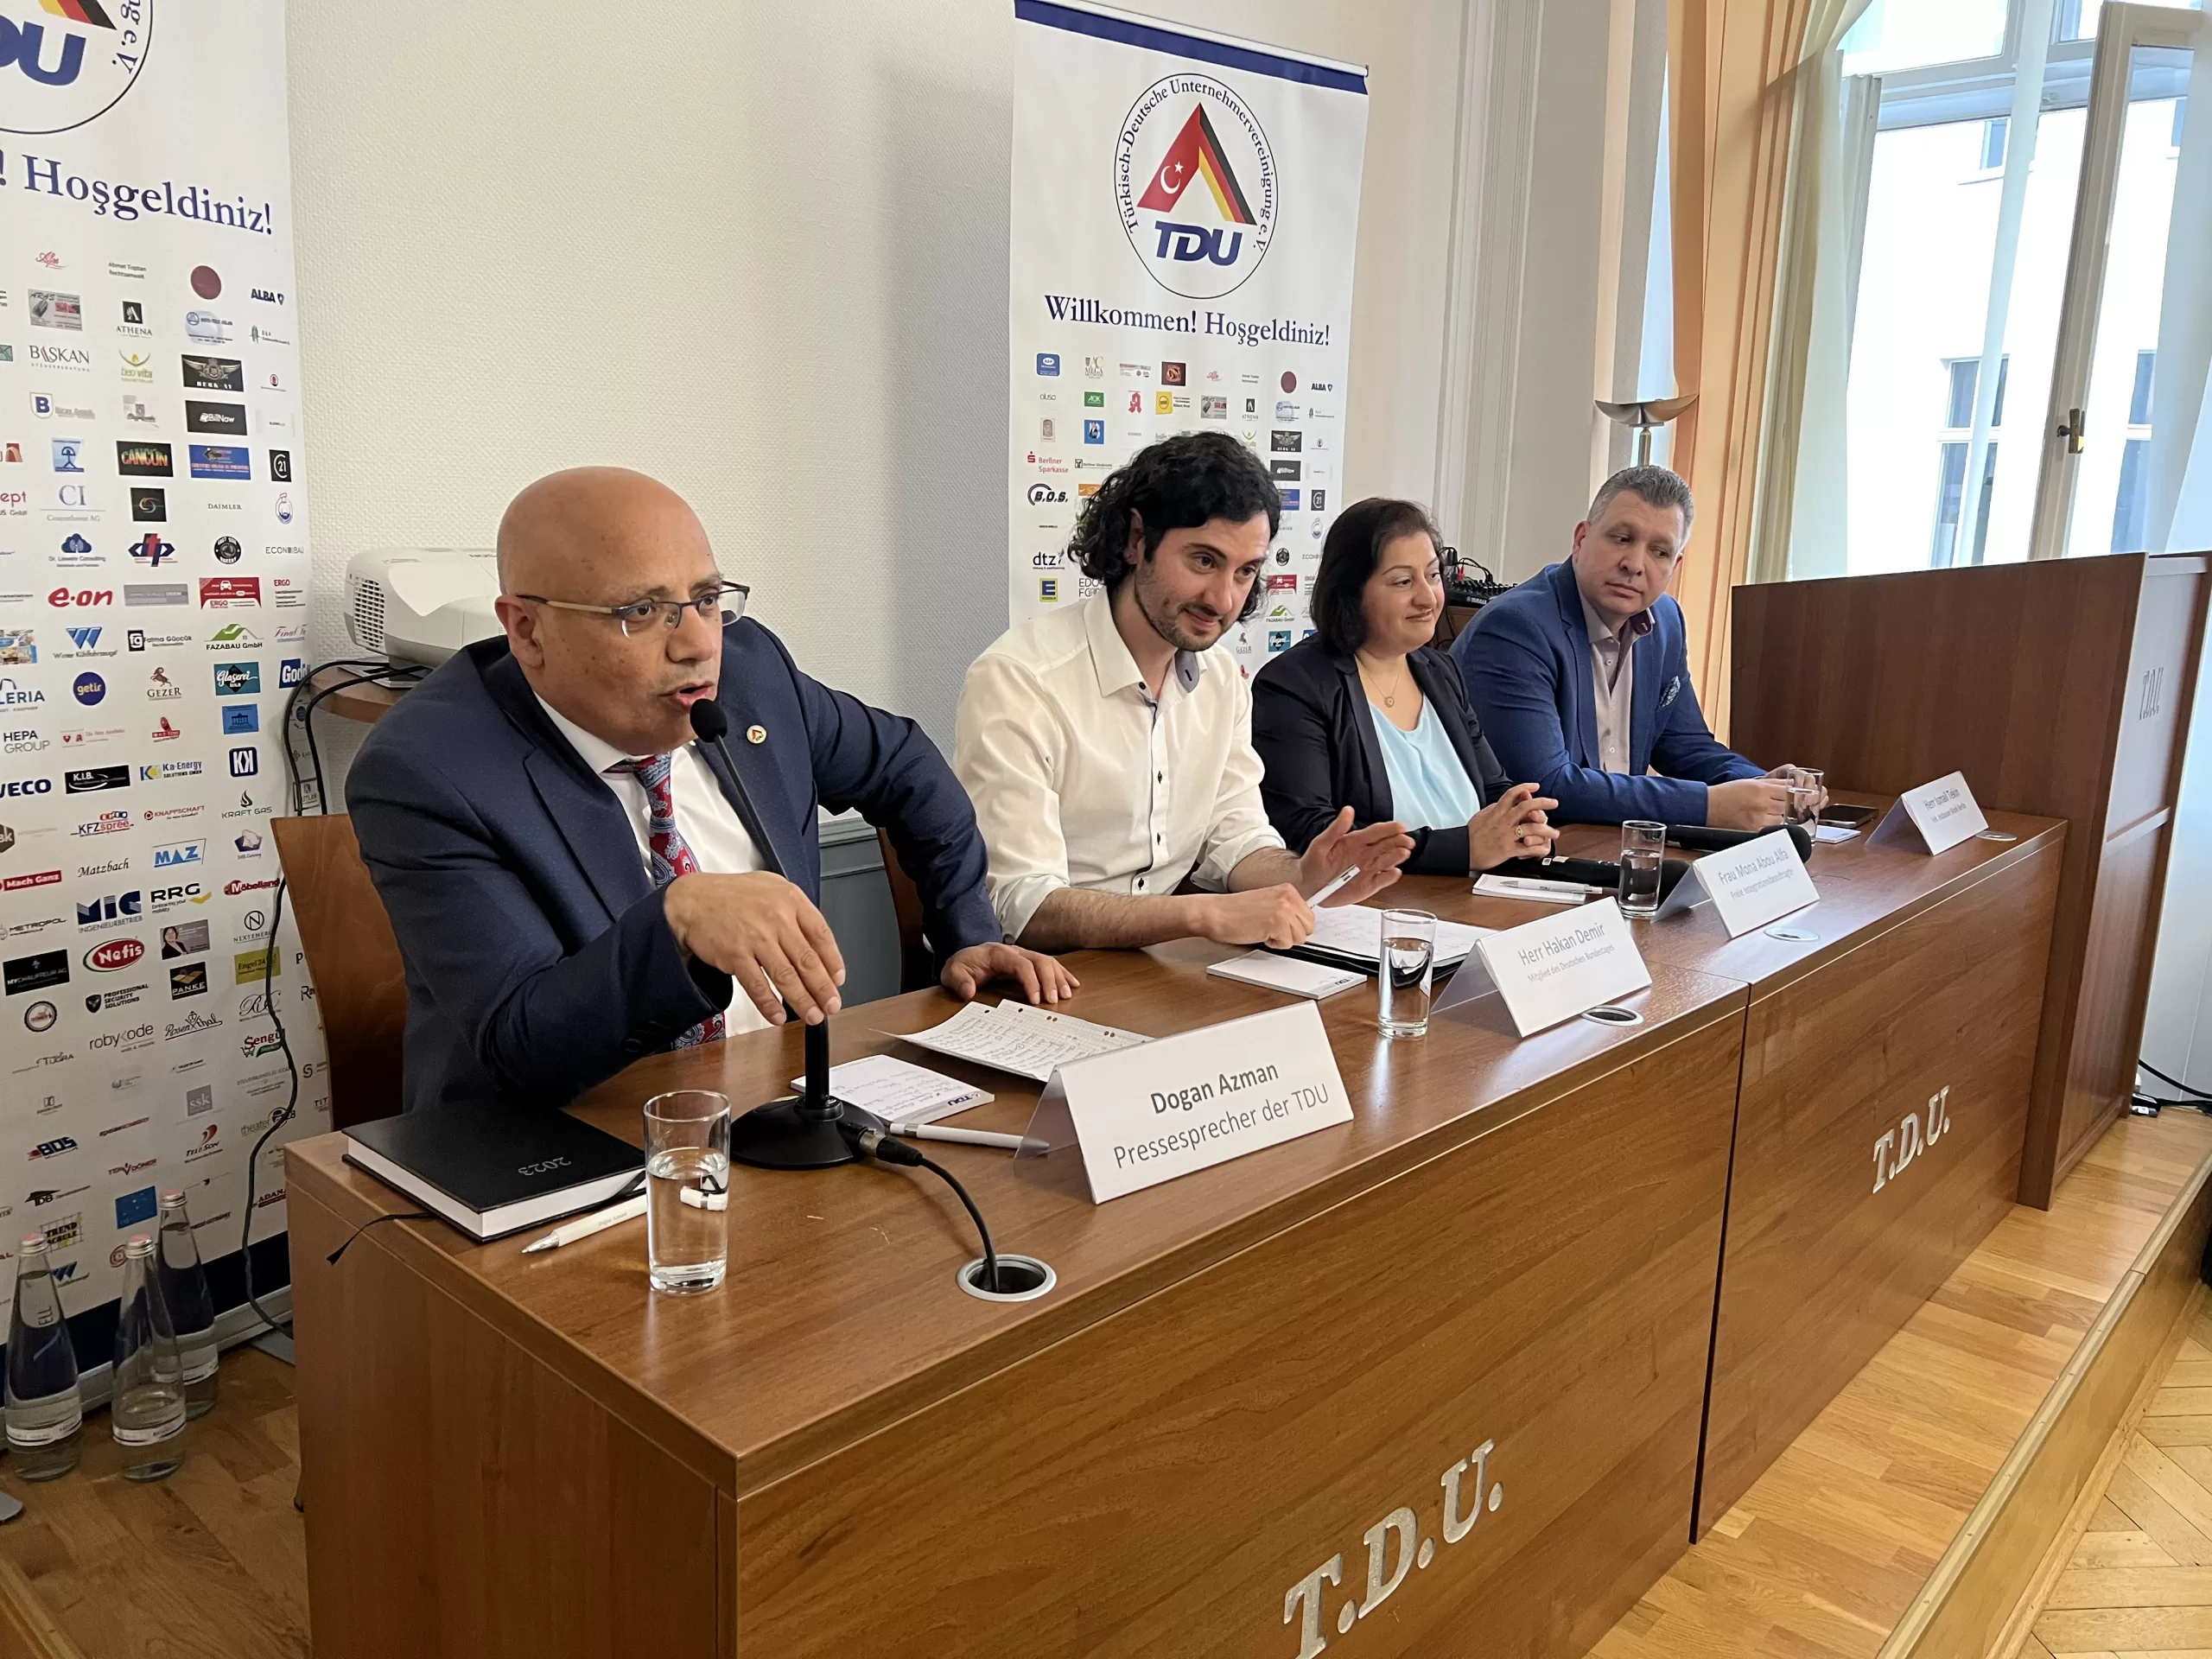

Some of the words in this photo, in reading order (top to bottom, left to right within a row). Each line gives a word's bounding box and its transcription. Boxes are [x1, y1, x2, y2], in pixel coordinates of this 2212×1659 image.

[1118, 88, 1168, 234] Türkisch-Deutsche
[1169, 79, 1274, 221] Unternehmervereinigung
[22, 154, 272, 235] Hoşgeldiniz!
[1154, 220, 1243, 266] TDU
[251, 289, 276, 303] ALBA
[1045, 295, 1196, 334] Willkommen!
[1205, 311, 1330, 346] Hoşgeldiniz!
[116, 326, 153, 336] ATHENA
[1034, 492, 1068, 503] B.O.S.
[1033, 551, 1056, 566] dtz
[216, 671, 257, 687] Glaserei
[78, 683, 101, 696] getir
[148, 688, 181, 697] GEZER
[3, 730, 38, 742] HEPA
[4, 741, 50, 753] GROUP
[155, 805, 205, 817] KNAPPSCHAFT
[221, 810, 251, 819] KRAFT
[254, 806, 272, 815] GAS
[155, 845, 199, 865] MAZ
[78, 858, 129, 877] Matzbach
[1718, 871, 1737, 886] Frau
[1735, 862, 1758, 878] Mona
[1757, 855, 1775, 872] Abou
[6, 878, 34, 888] Mach
[35, 874, 60, 883] Ganz
[150, 882, 200, 903] RRG
[9, 918, 67, 931] METROPOL
[78, 916, 143, 934] INGENIEURBETRIEB
[1517, 946, 1544, 966] Herr
[1542, 936, 1577, 956] Hakan
[1574, 923, 1605, 945] Demir
[98, 944, 143, 964] Nefis
[1528, 969, 1551, 982] Mitglied
[1551, 965, 1561, 974] des
[1560, 957, 1586, 970] Deutschen
[1585, 944, 1614, 962] Bundestages
[104, 984, 149, 998] PROFESSIONAL
[173, 982, 206, 995] PANKE
[105, 993, 133, 1003] SECURITY
[105, 997, 140, 1009] SOLUTIONS
[1150, 1082, 1215, 1115] Dogan
[1219, 1064, 1280, 1096] Azman
[190, 1093, 211, 1109] ssk
[1114, 1108, 1256, 1169] Pressesprecher
[1262, 1098, 1290, 1122] der
[1291, 1084, 1329, 1112] TDU
[1872, 1085, 1950, 1194] T.D.U.
[518, 1156, 572, 1176] 2023
[258, 1189, 286, 1202] ADAN
[1283, 1438, 1504, 1659] T.D.U.
